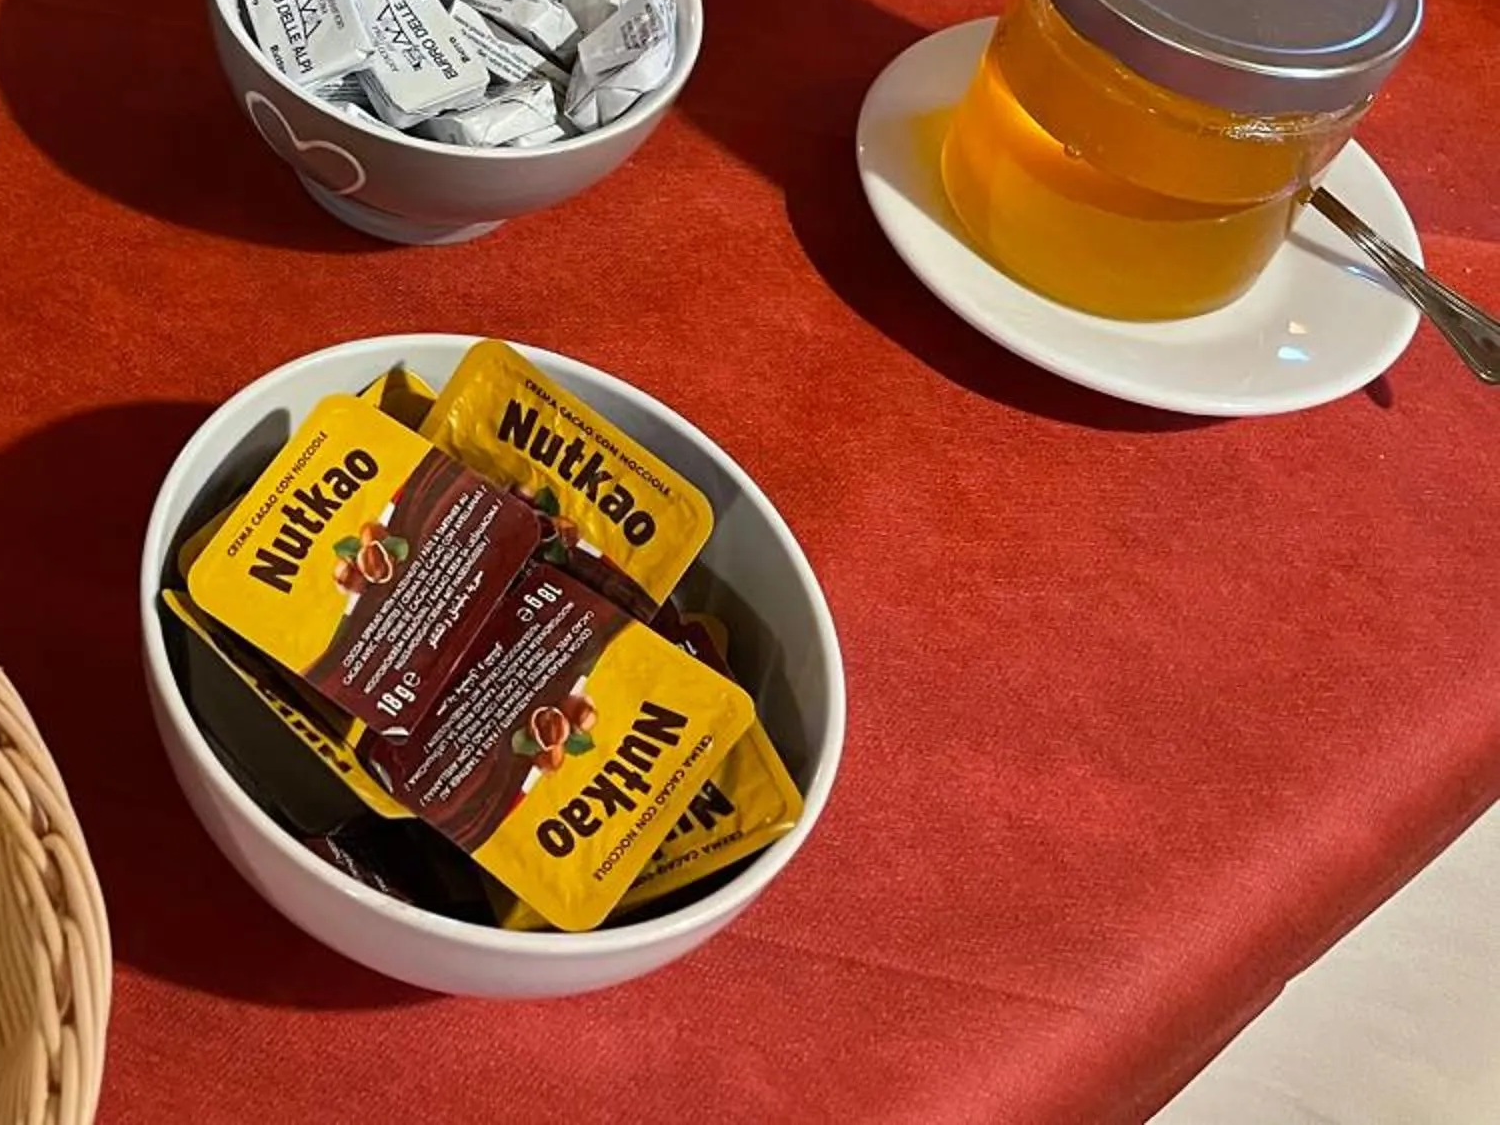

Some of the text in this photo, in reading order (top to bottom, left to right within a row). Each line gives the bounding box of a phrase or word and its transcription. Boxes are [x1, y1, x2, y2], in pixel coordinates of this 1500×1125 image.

[276, 2, 302, 44] DELLE
[291, 44, 313, 73] ALPI
[421, 33, 458, 83] BURRO
[522, 377, 673, 497] CREMA CACAO CON NOCCIOLE
[224, 429, 329, 557] CREMA CACAO CON NOCCIOLE
[496, 397, 658, 549] Nutkao
[248, 447, 380, 594] Nutkao
[534, 700, 688, 859] Nutkao
[681, 732, 714, 770] CREMA
[634, 804, 658, 830] CON
[652, 767, 686, 807] CACAO
[591, 827, 638, 882] NOCCIOLE
